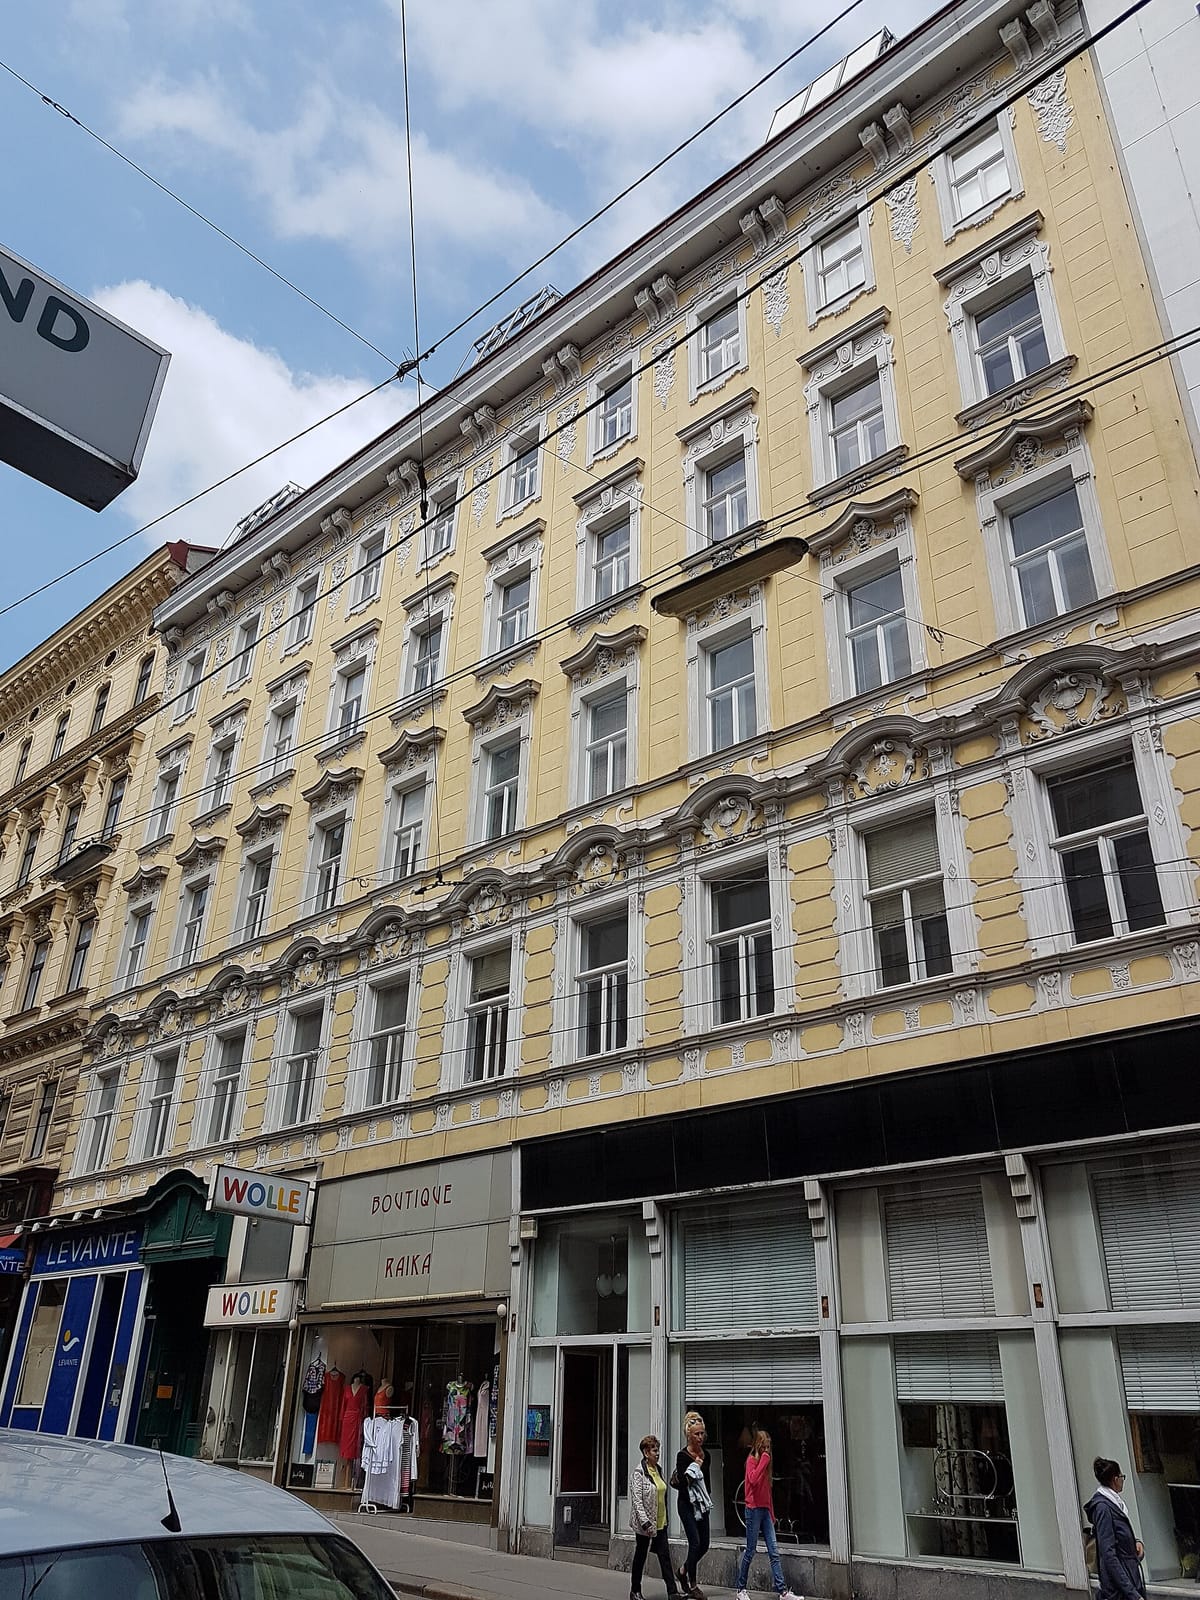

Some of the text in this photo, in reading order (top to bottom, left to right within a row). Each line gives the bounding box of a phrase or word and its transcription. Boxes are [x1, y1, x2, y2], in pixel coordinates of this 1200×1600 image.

[224, 1176, 302, 1214] WOLLE
[371, 1184, 452, 1215] BOUTIQUE
[46, 1230, 137, 1266] LEVANTE
[384, 1253, 432, 1278] RAIKA
[222, 1289, 278, 1316] WOLLE
